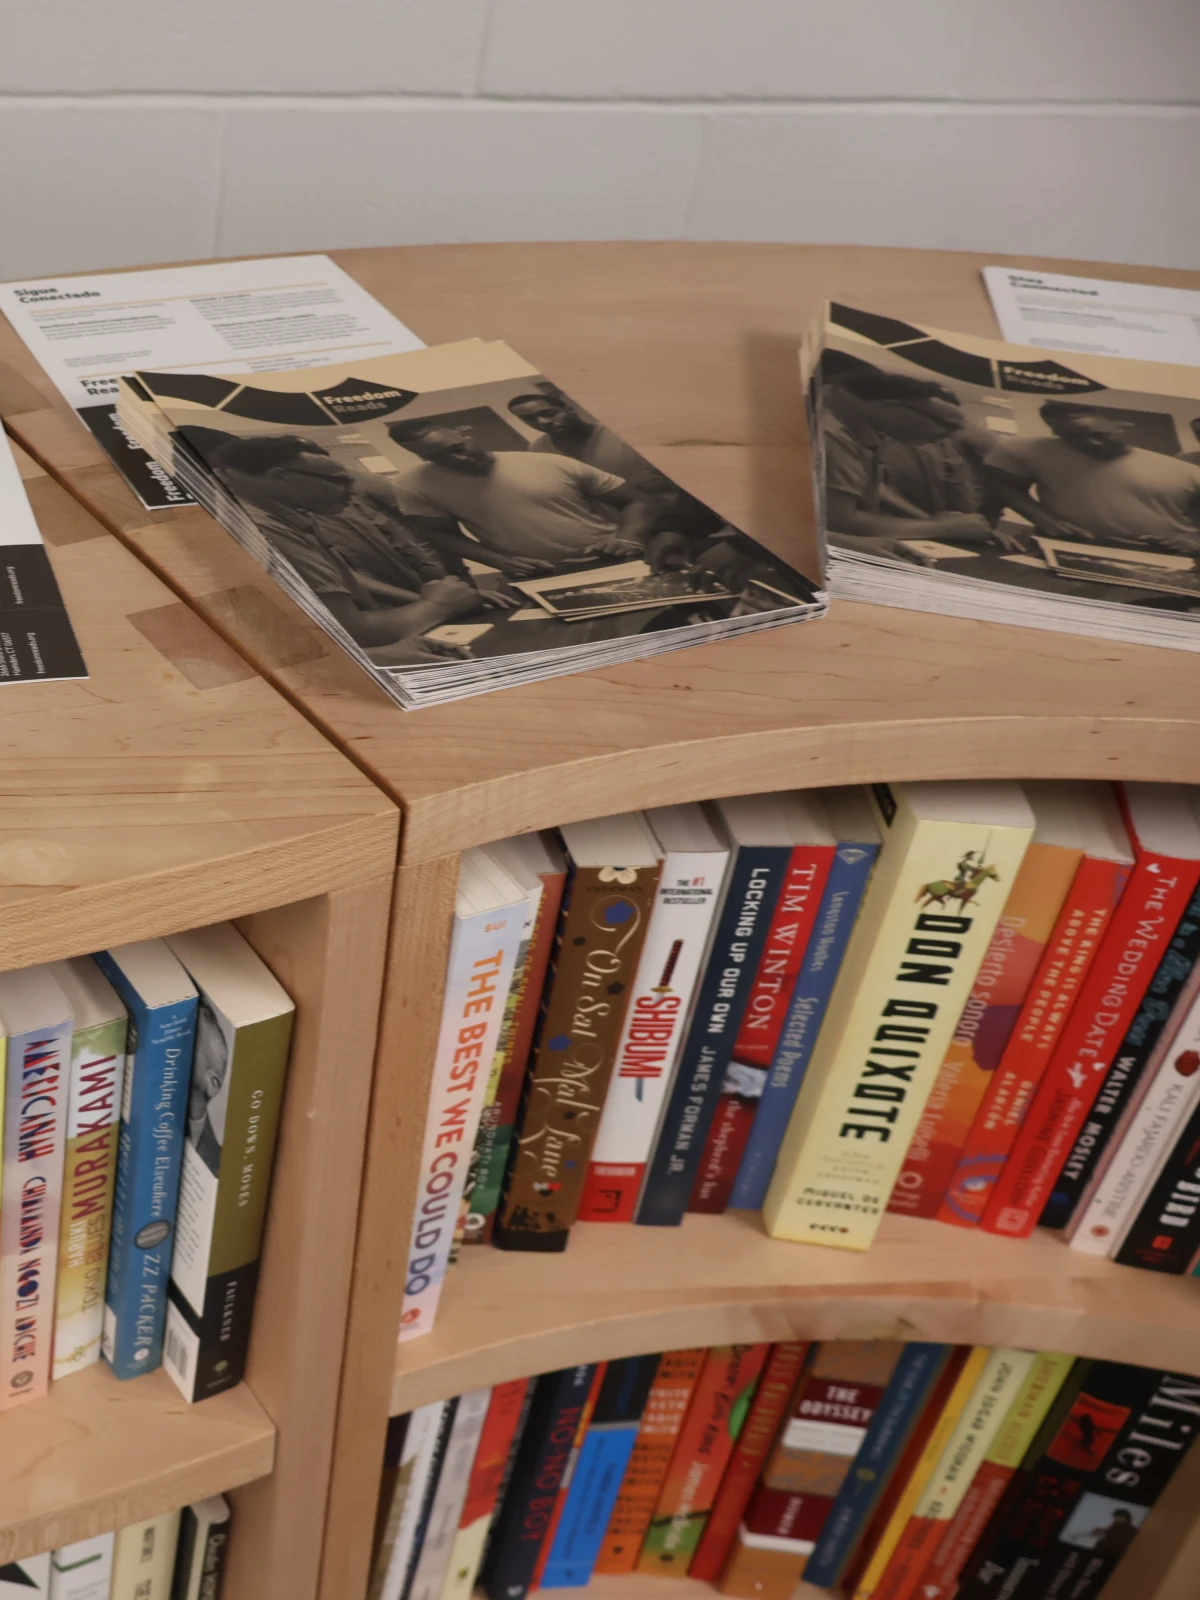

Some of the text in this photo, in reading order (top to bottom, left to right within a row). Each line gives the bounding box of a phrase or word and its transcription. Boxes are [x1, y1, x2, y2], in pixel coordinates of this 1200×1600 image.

[13, 287, 58, 297] Sigue
[18, 291, 102, 304] Conectado
[323, 390, 402, 405] Freedom
[1003, 366, 1090, 386] Freedom
[332, 401, 388, 414] Reads
[145, 461, 186, 501] Freedom
[690, 877, 706, 887] #1
[780, 864, 817, 913] TIM
[583, 949, 620, 989] On
[707, 868, 770, 1034] LOCKING UP OUR OWN
[746, 922, 799, 1030] WINTON
[896, 913, 974, 986] DON
[978, 915, 1027, 987] Desierto
[1077, 876, 1179, 1059] THE WEDDING DATE
[570, 995, 610, 1037] Sal
[618, 996, 682, 1078] SHIBUMI
[770, 997, 820, 1089] Selected Poems
[692, 1047, 717, 1089] JAMES
[838, 999, 939, 1144] QUIXOTE
[18, 1037, 61, 1163] AMERICANAH
[404, 950, 504, 1297] THE BEST WE COULD DO
[679, 1092, 704, 1152] FORMAN
[1063, 1057, 1136, 1180] WALTER MOSLEY
[67, 1054, 117, 1268] HARUKI MURAKAMI
[150, 1048, 181, 1217] Drinking Coffee Elsewhere
[85, 1214, 106, 1264] BLUES
[17, 1257, 40, 1311] NGOZI
[136, 1279, 158, 1348] PACKER
[12, 1313, 37, 1363] ADICHIE
[799, 1400, 874, 1422] ODYSSEY
[826, 1386, 861, 1403] THE
[1105, 1375, 1200, 1489] Miles
[522, 1406, 582, 1540] NO-NO BOY
